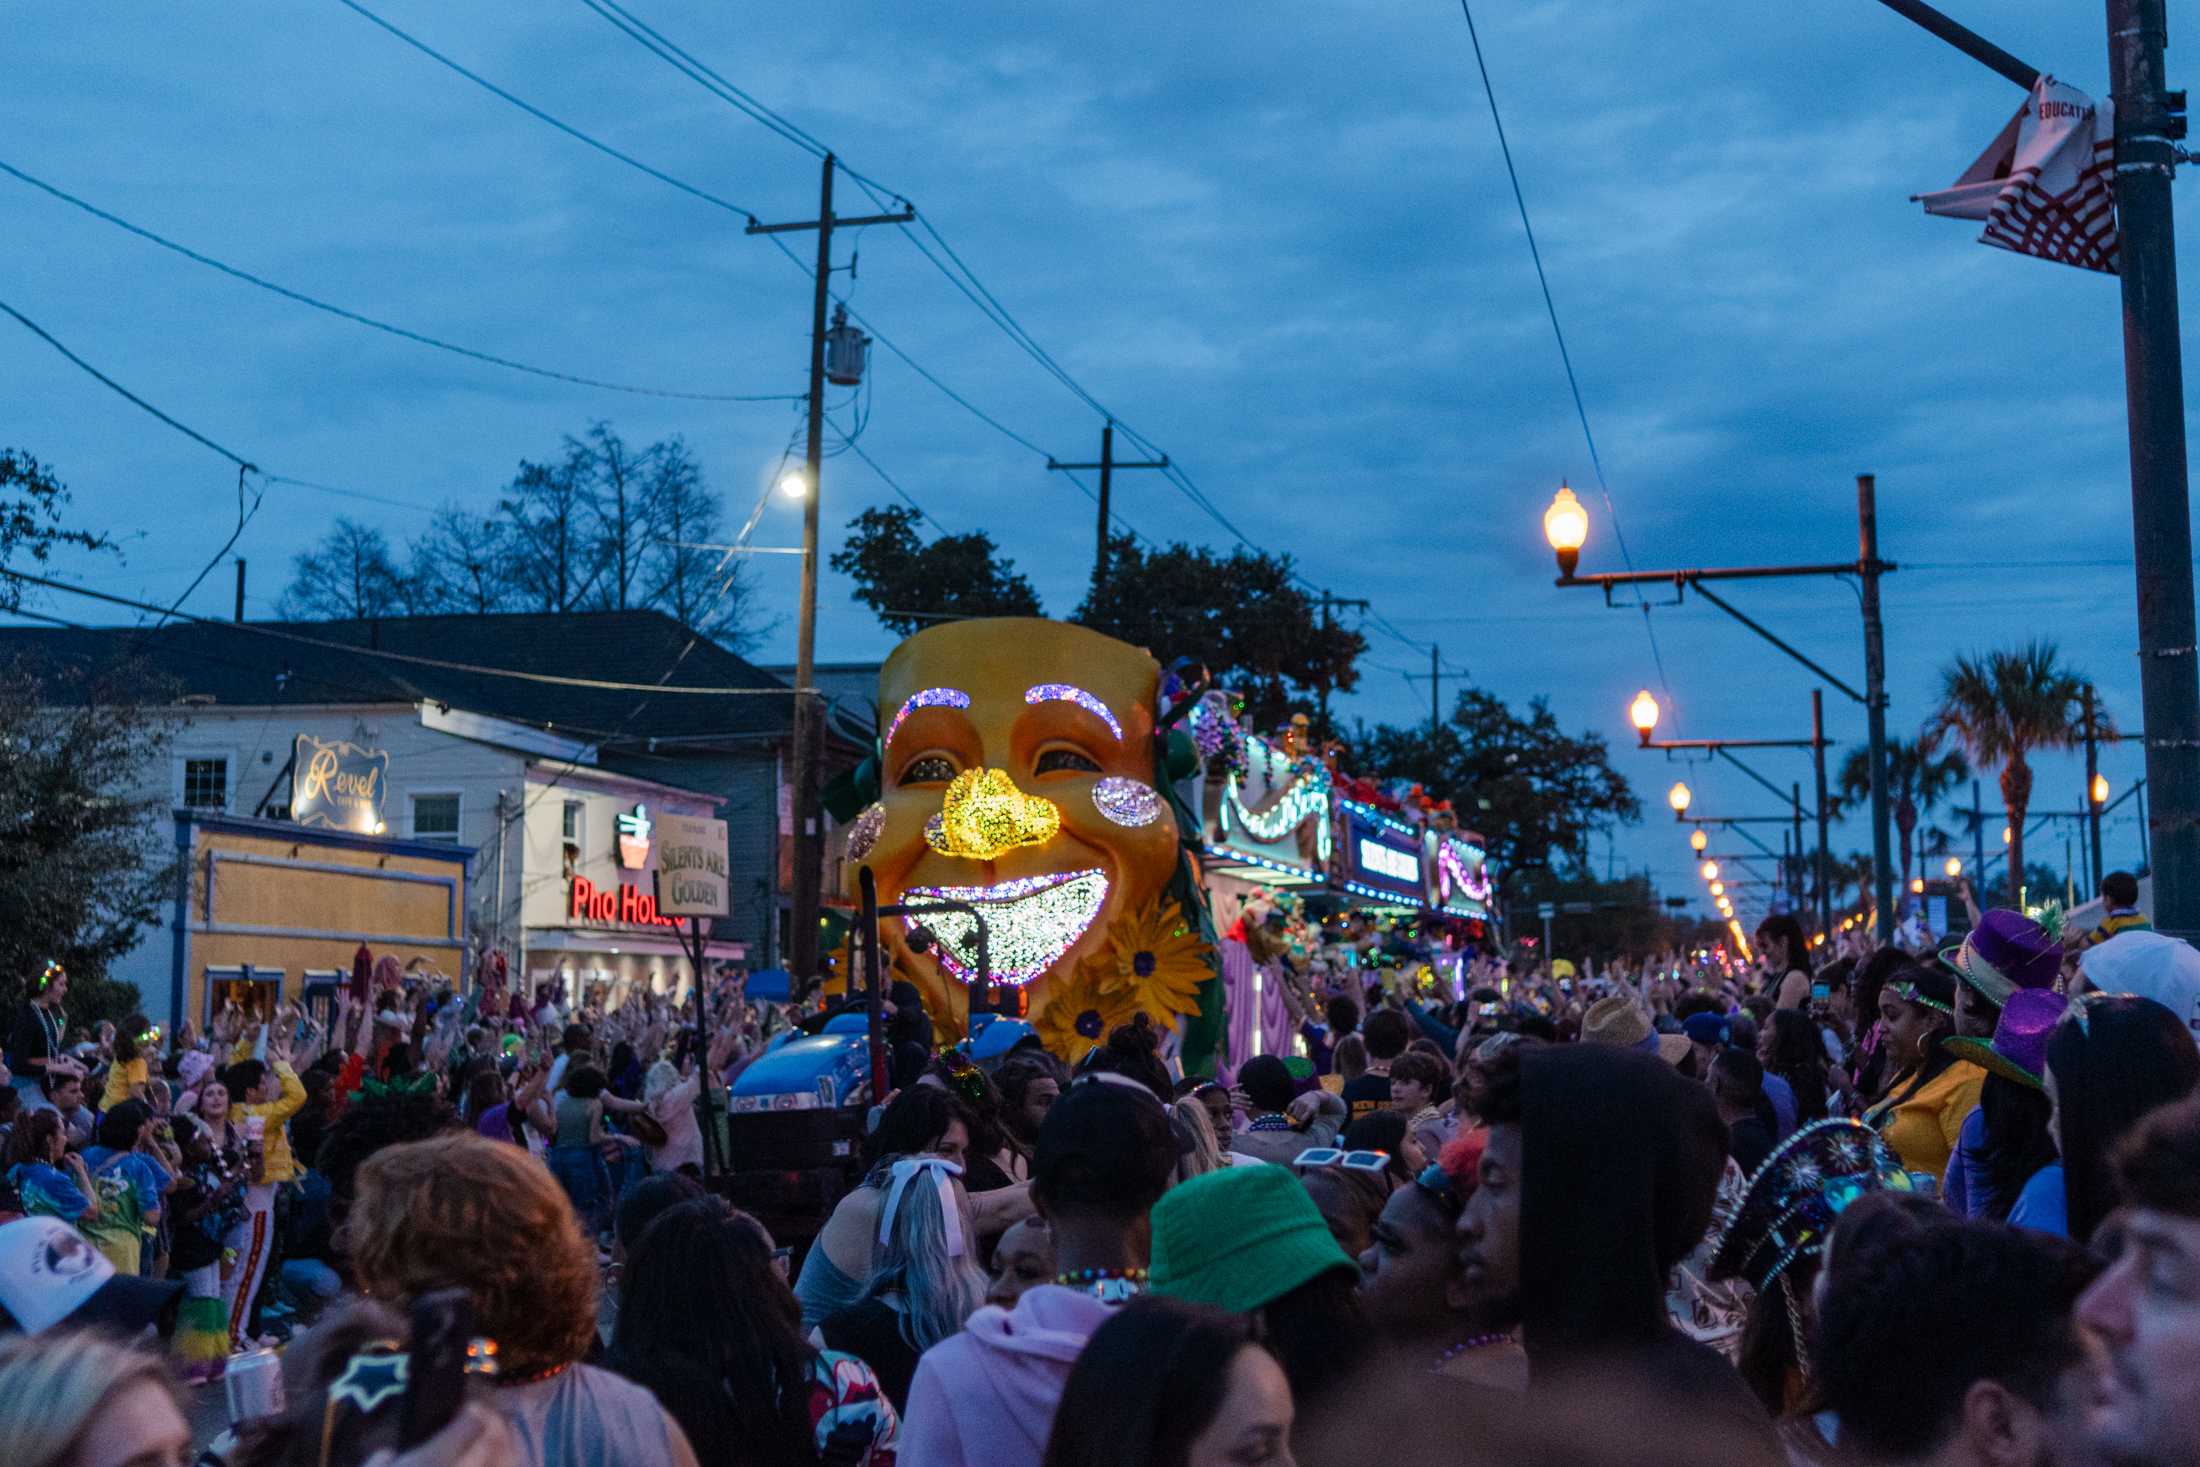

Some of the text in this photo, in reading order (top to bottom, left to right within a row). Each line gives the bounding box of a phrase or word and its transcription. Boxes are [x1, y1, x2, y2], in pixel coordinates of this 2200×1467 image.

[305, 749, 378, 807] Revel
[660, 840, 726, 878] SILENTS ARE
[573, 876, 617, 921] Pho
[671, 872, 718, 907] GOLDEN
